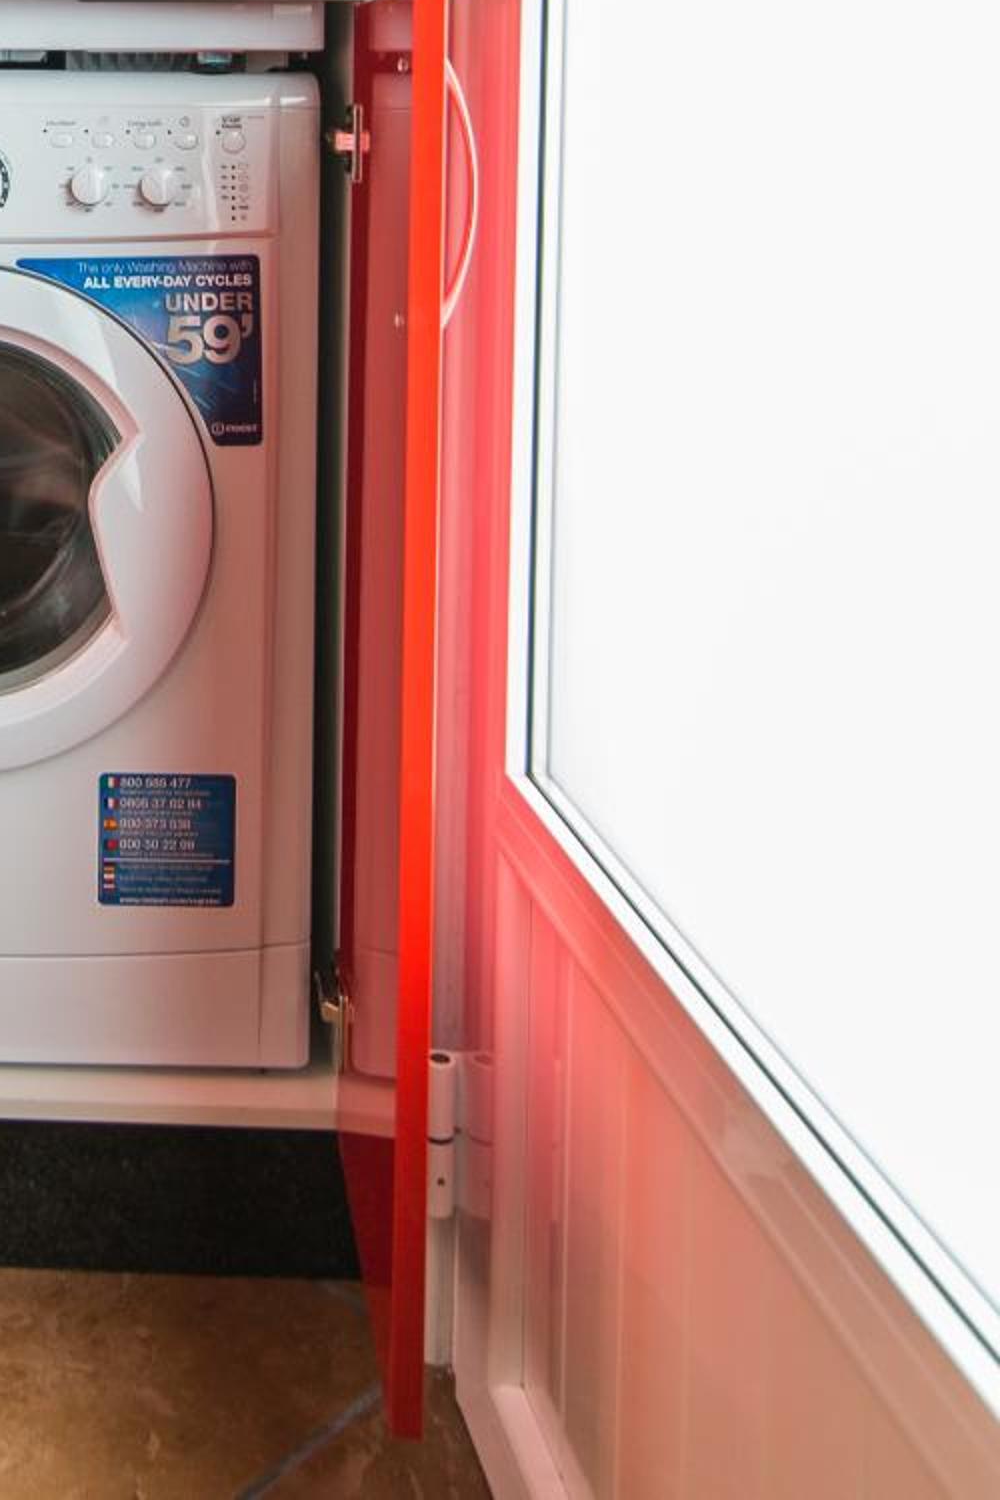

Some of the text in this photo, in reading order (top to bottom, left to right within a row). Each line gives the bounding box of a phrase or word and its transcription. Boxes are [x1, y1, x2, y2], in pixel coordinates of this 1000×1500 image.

[79, 262, 98, 274] The
[101, 261, 124, 275] only
[127, 260, 177, 275] Washing
[179, 260, 226, 273] Machine
[83, 273, 253, 290] ALL EVERY-DAY CYCLES
[165, 291, 253, 312] UNDER
